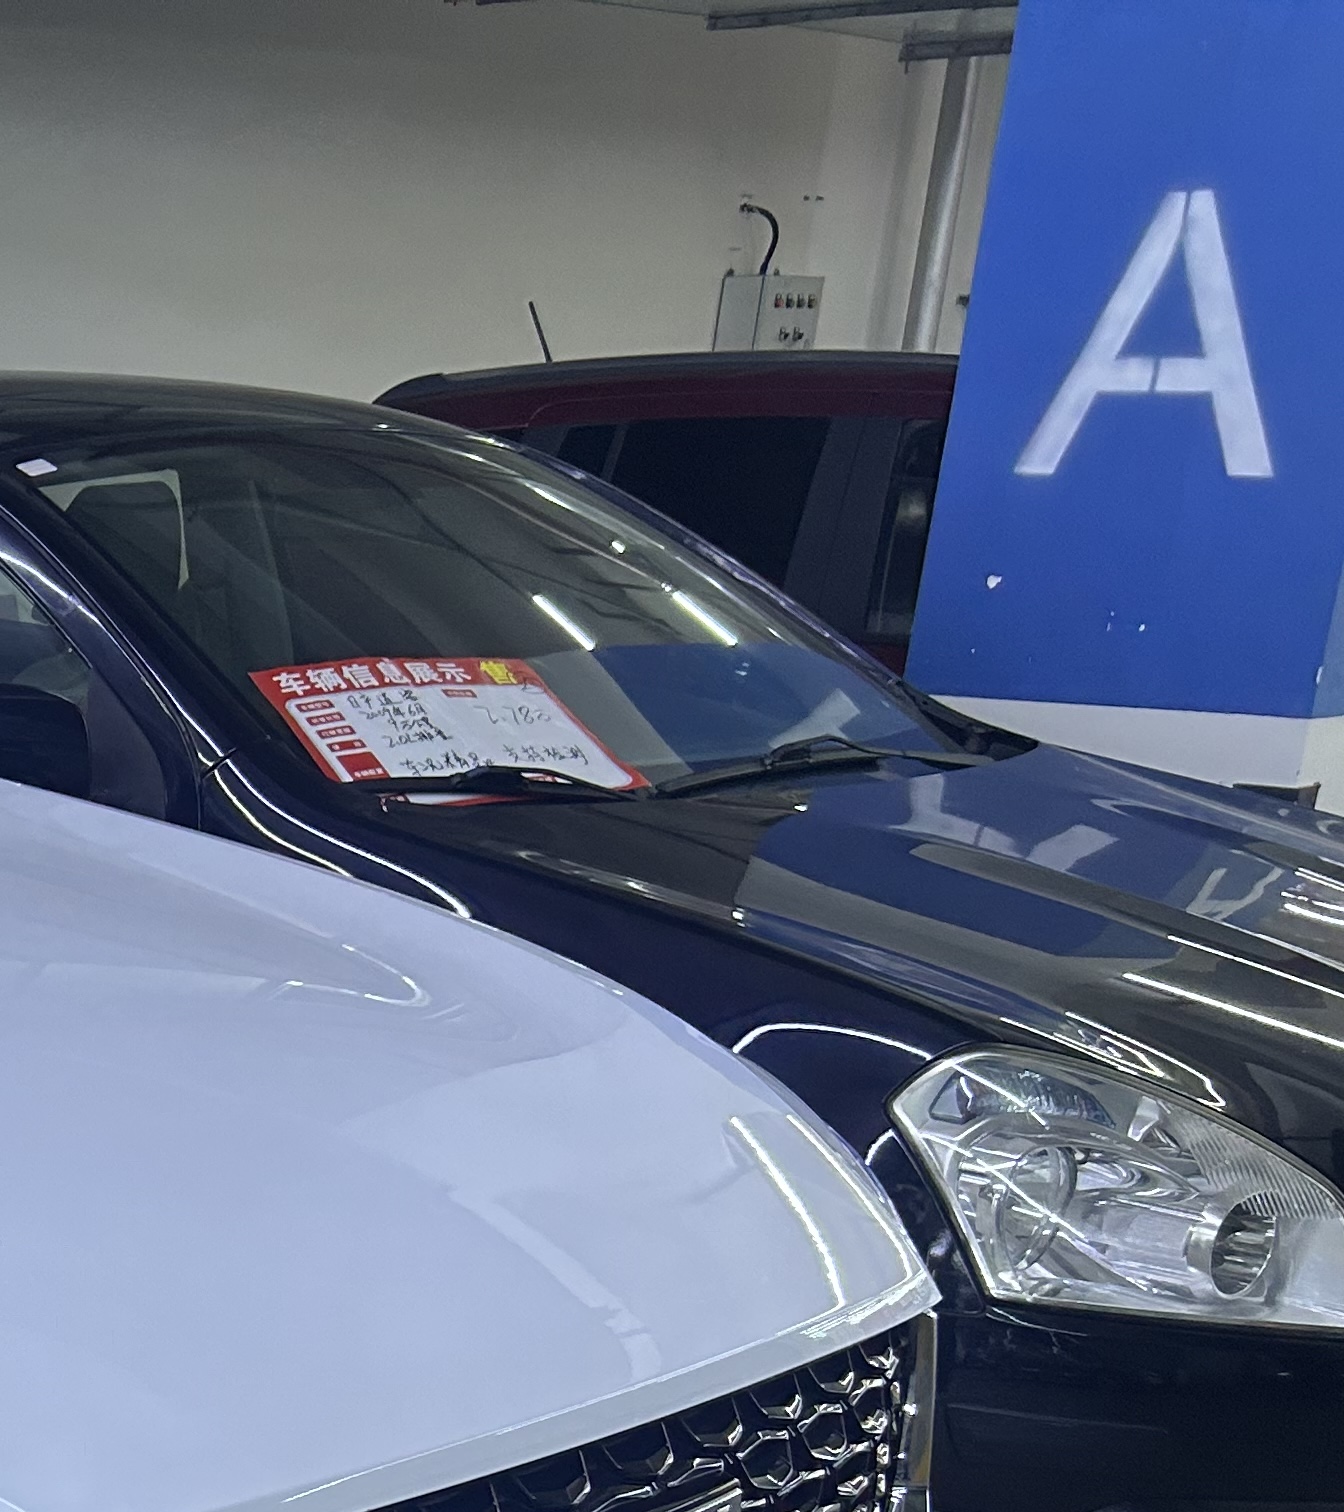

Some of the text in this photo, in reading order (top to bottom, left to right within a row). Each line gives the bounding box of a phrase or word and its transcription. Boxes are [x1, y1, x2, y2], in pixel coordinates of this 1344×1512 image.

[1014, 188, 1274, 478] A
[272, 661, 472, 696] 车辆信息展示
